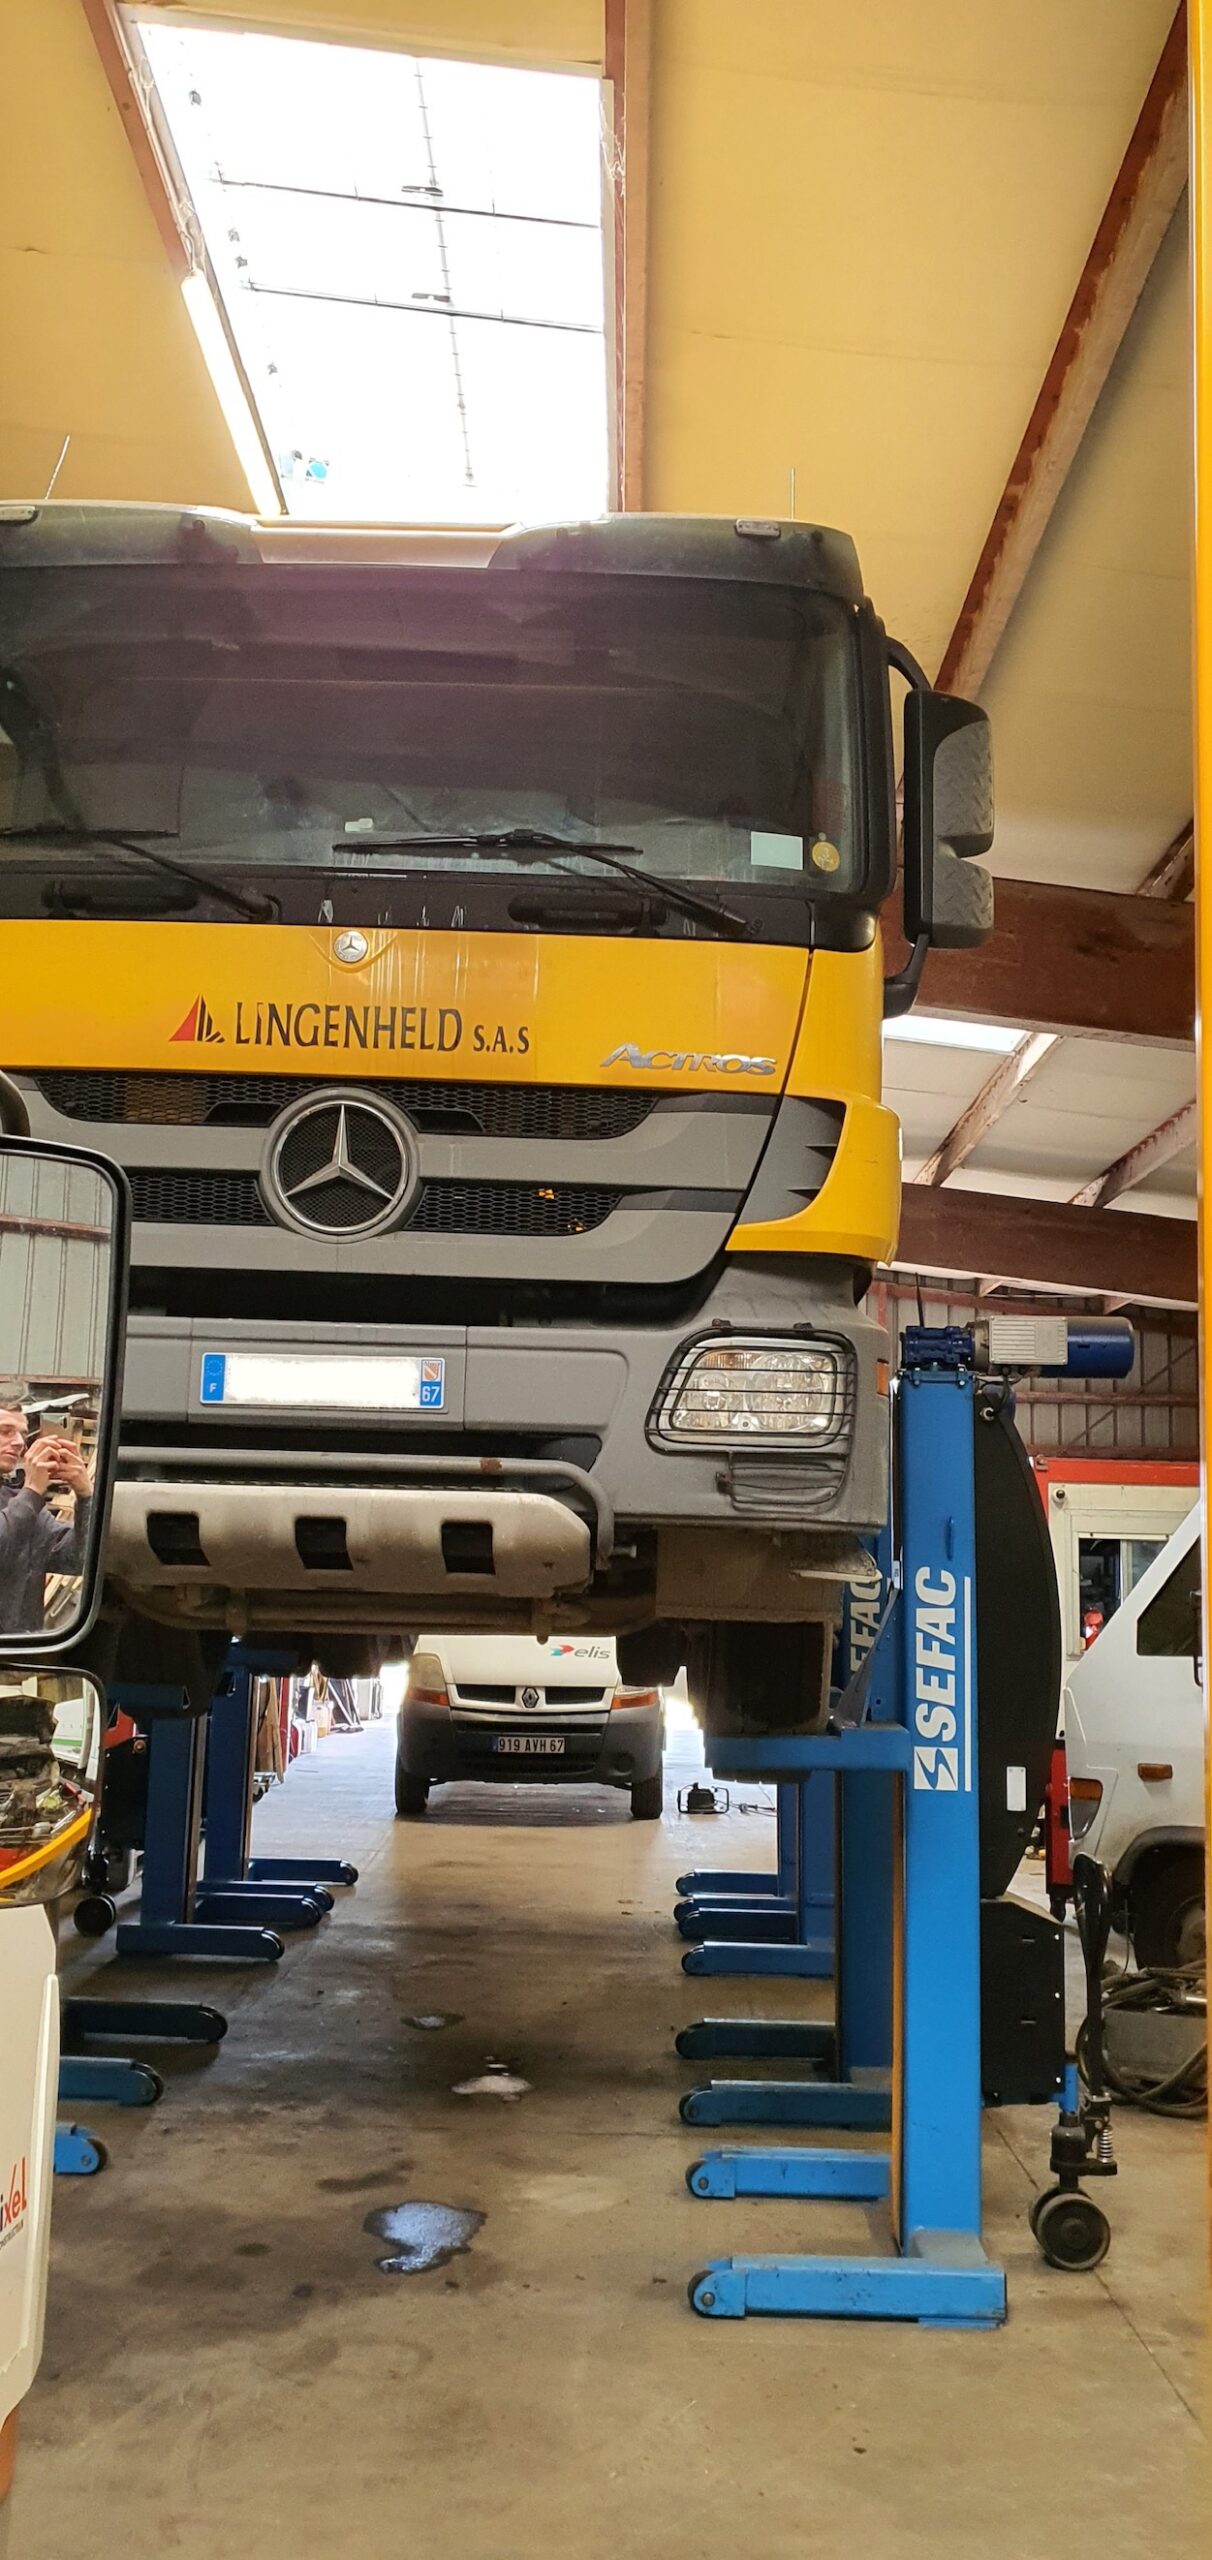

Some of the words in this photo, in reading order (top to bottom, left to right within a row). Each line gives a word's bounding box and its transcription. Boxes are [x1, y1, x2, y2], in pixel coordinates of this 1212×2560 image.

[235, 1001, 463, 1052] LINGENHELD
[472, 1024, 530, 1055] S.A.S
[209, 1382, 217, 1393] F
[422, 1386, 440, 1402] 67
[850, 1580, 881, 1673] FAC
[574, 1645, 611, 1660] elis
[915, 1566, 957, 1742] SEFAC
[499, 1738, 520, 1751] 919
[525, 1739, 546, 1752] AVH
[550, 1739, 564, 1752] 67
